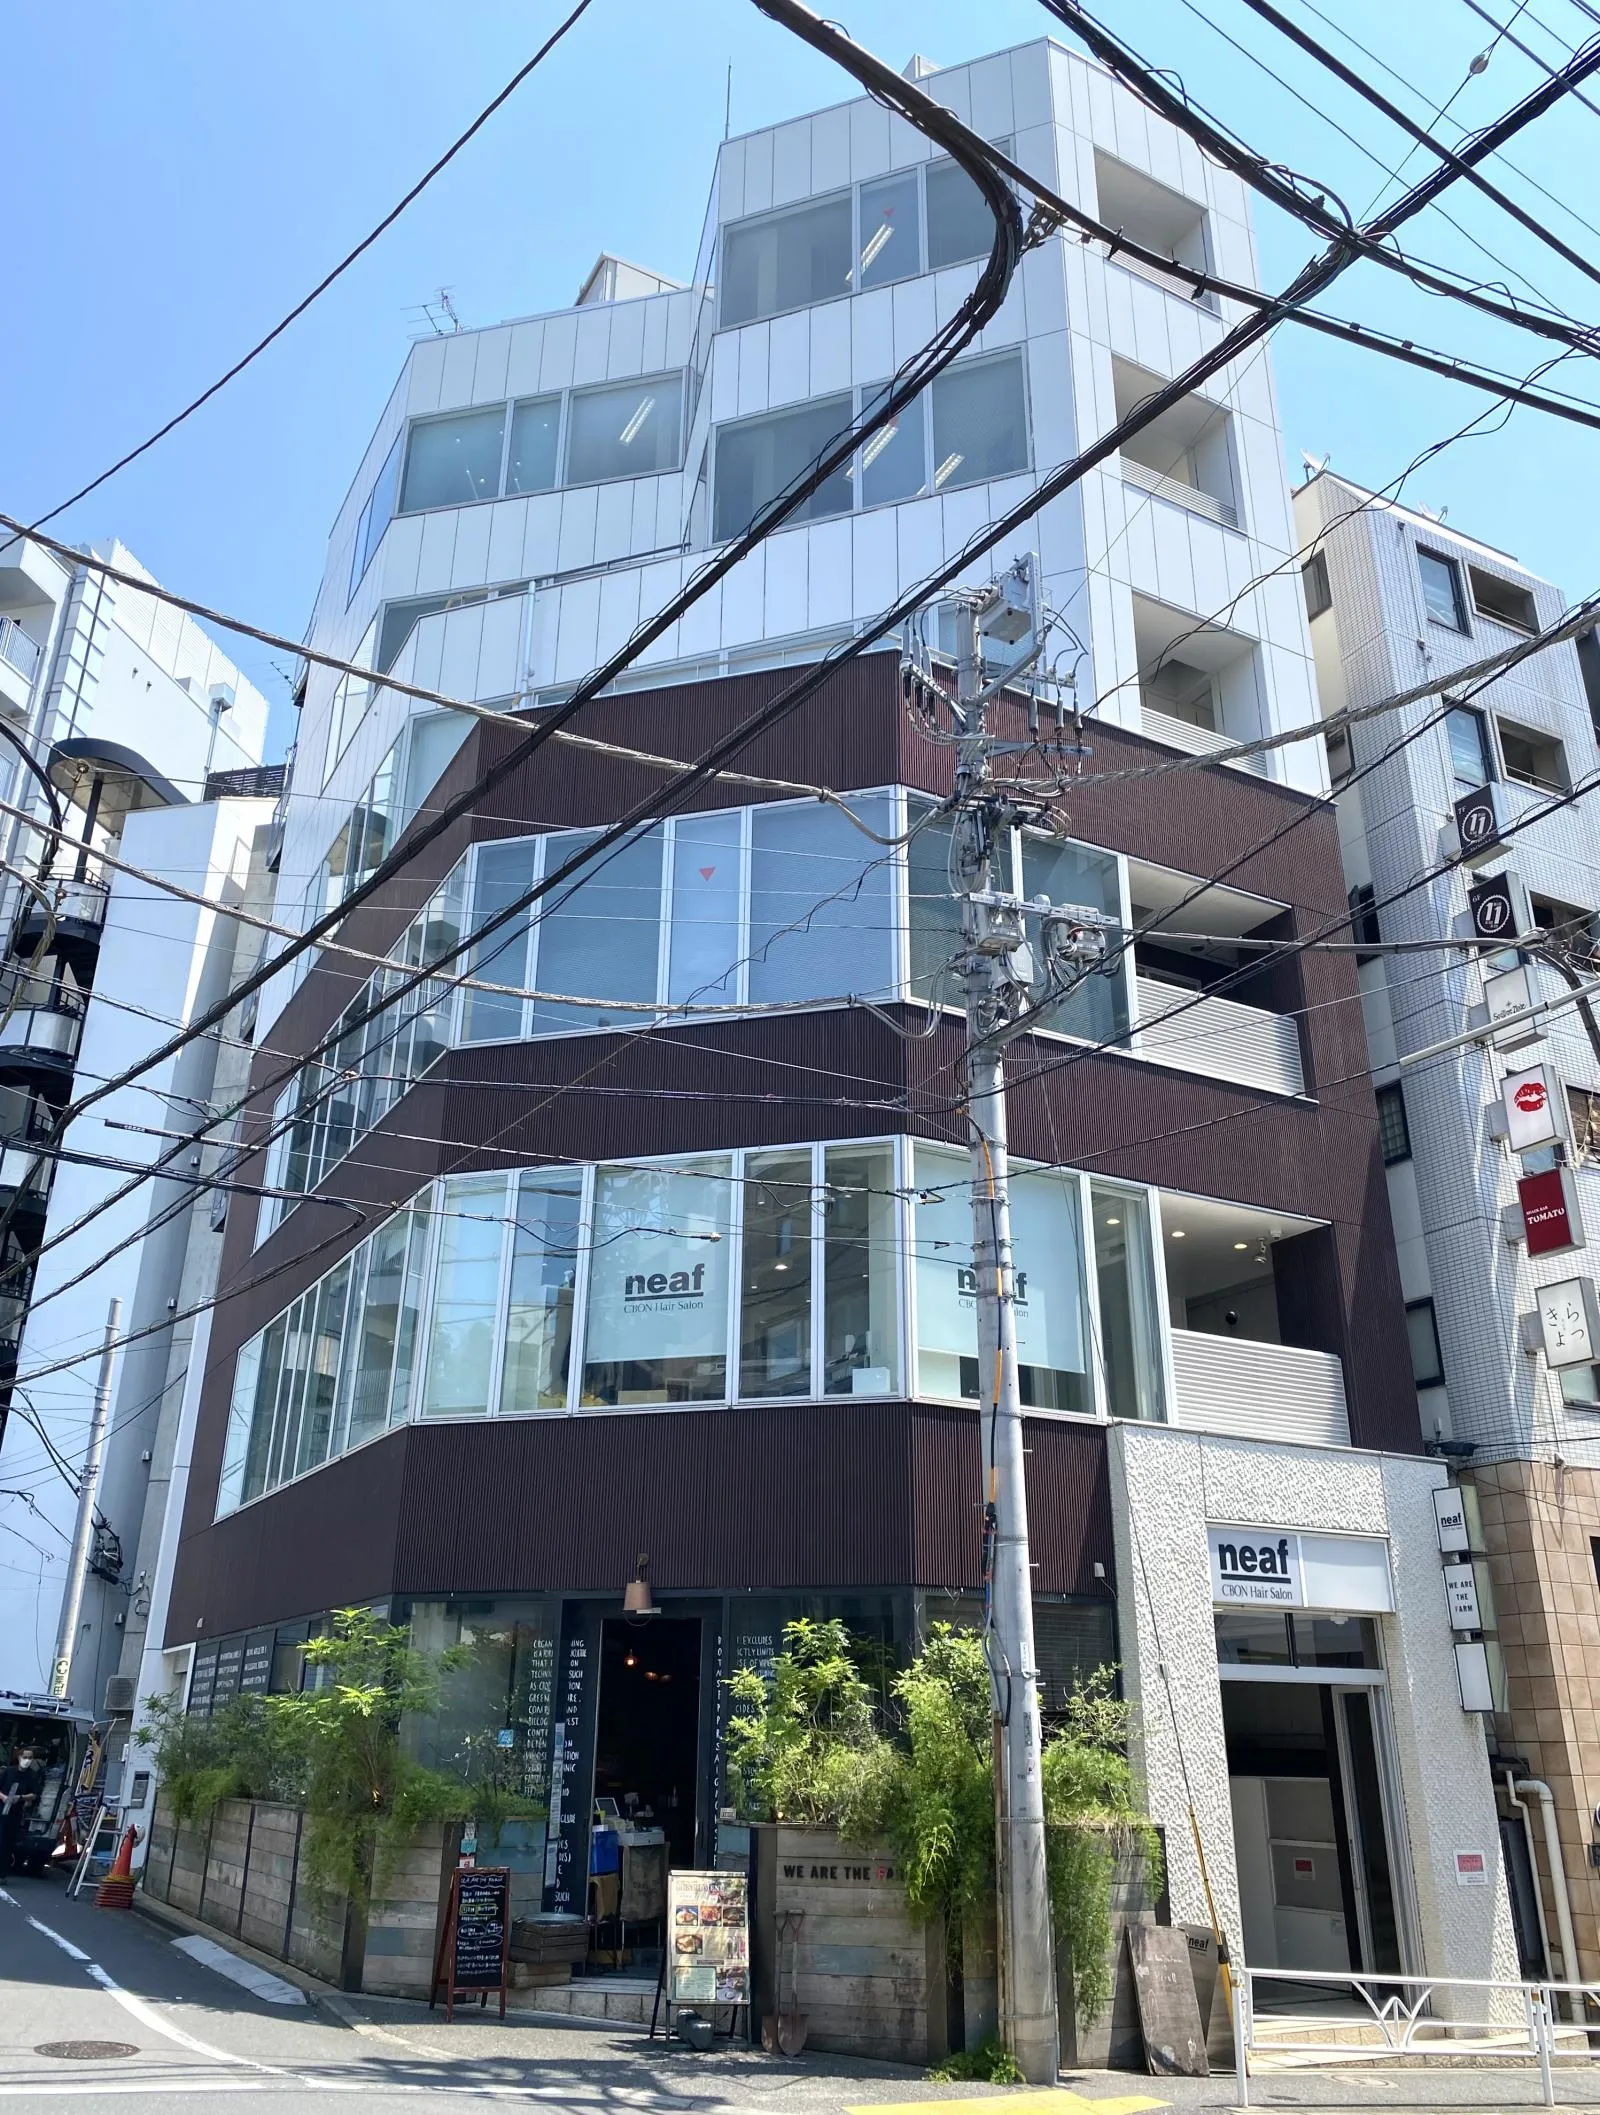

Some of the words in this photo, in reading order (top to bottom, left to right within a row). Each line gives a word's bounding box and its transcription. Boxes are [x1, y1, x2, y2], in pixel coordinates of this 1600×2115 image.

[1527, 1207, 1566, 1225] TOMATO
[625, 1263, 704, 1295] neaf
[958, 1268, 1028, 1299] nf
[678, 1299, 704, 1311] Salon
[1440, 1512, 1462, 1526] neaf
[1218, 1538, 1289, 1575] neaf
[1250, 1585, 1269, 1599] Hair
[1270, 1587, 1293, 1601] Salon
[1448, 1582, 1458, 1590] WE
[1460, 1580, 1473, 1588] ARE
[1456, 1593, 1469, 1601] THE
[783, 1864, 805, 1879] WE
[810, 1865, 838, 1880] ARE
[843, 1866, 871, 1881] THE
